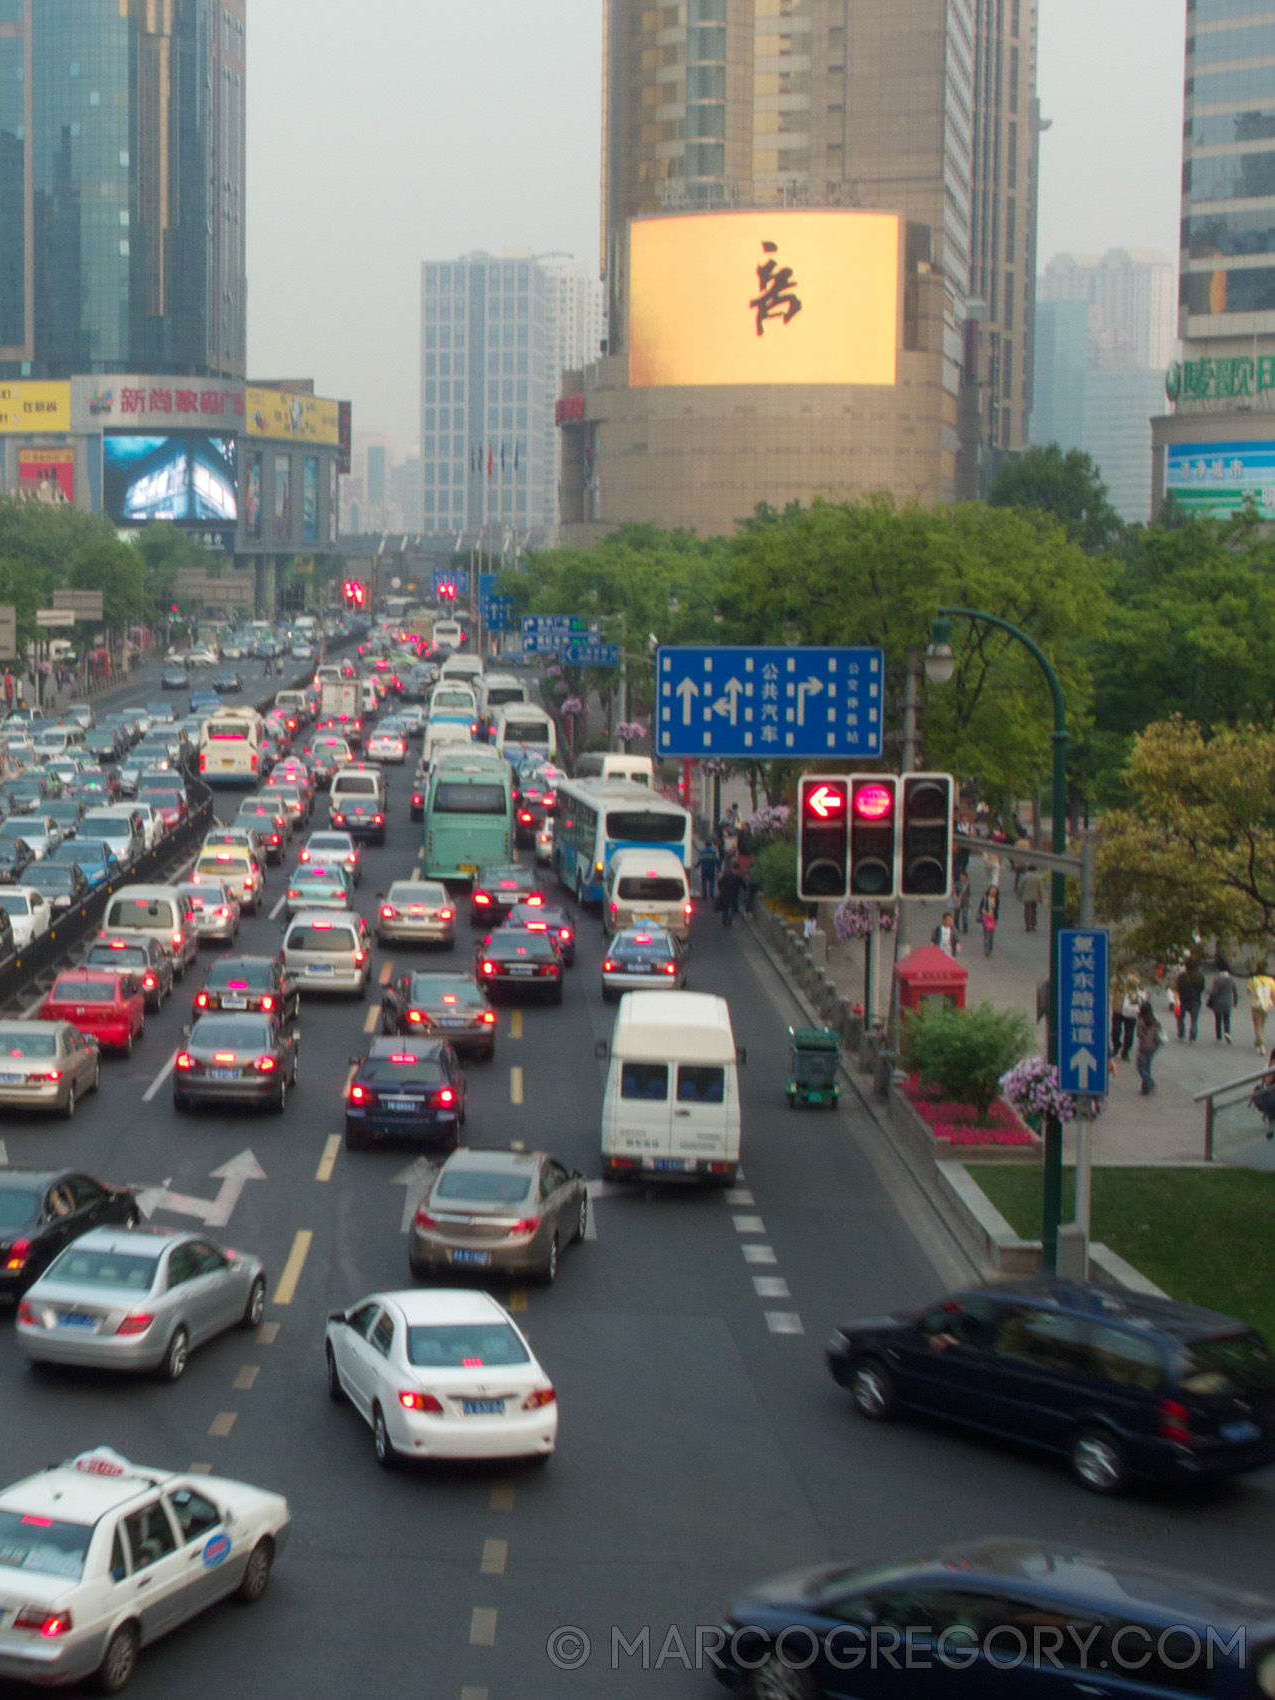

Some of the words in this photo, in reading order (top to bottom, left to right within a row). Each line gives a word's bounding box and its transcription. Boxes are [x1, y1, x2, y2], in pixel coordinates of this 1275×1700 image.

[761, 662, 779, 743] 公共汽车
[1071, 935, 1095, 1045] 复兴东路隧道
